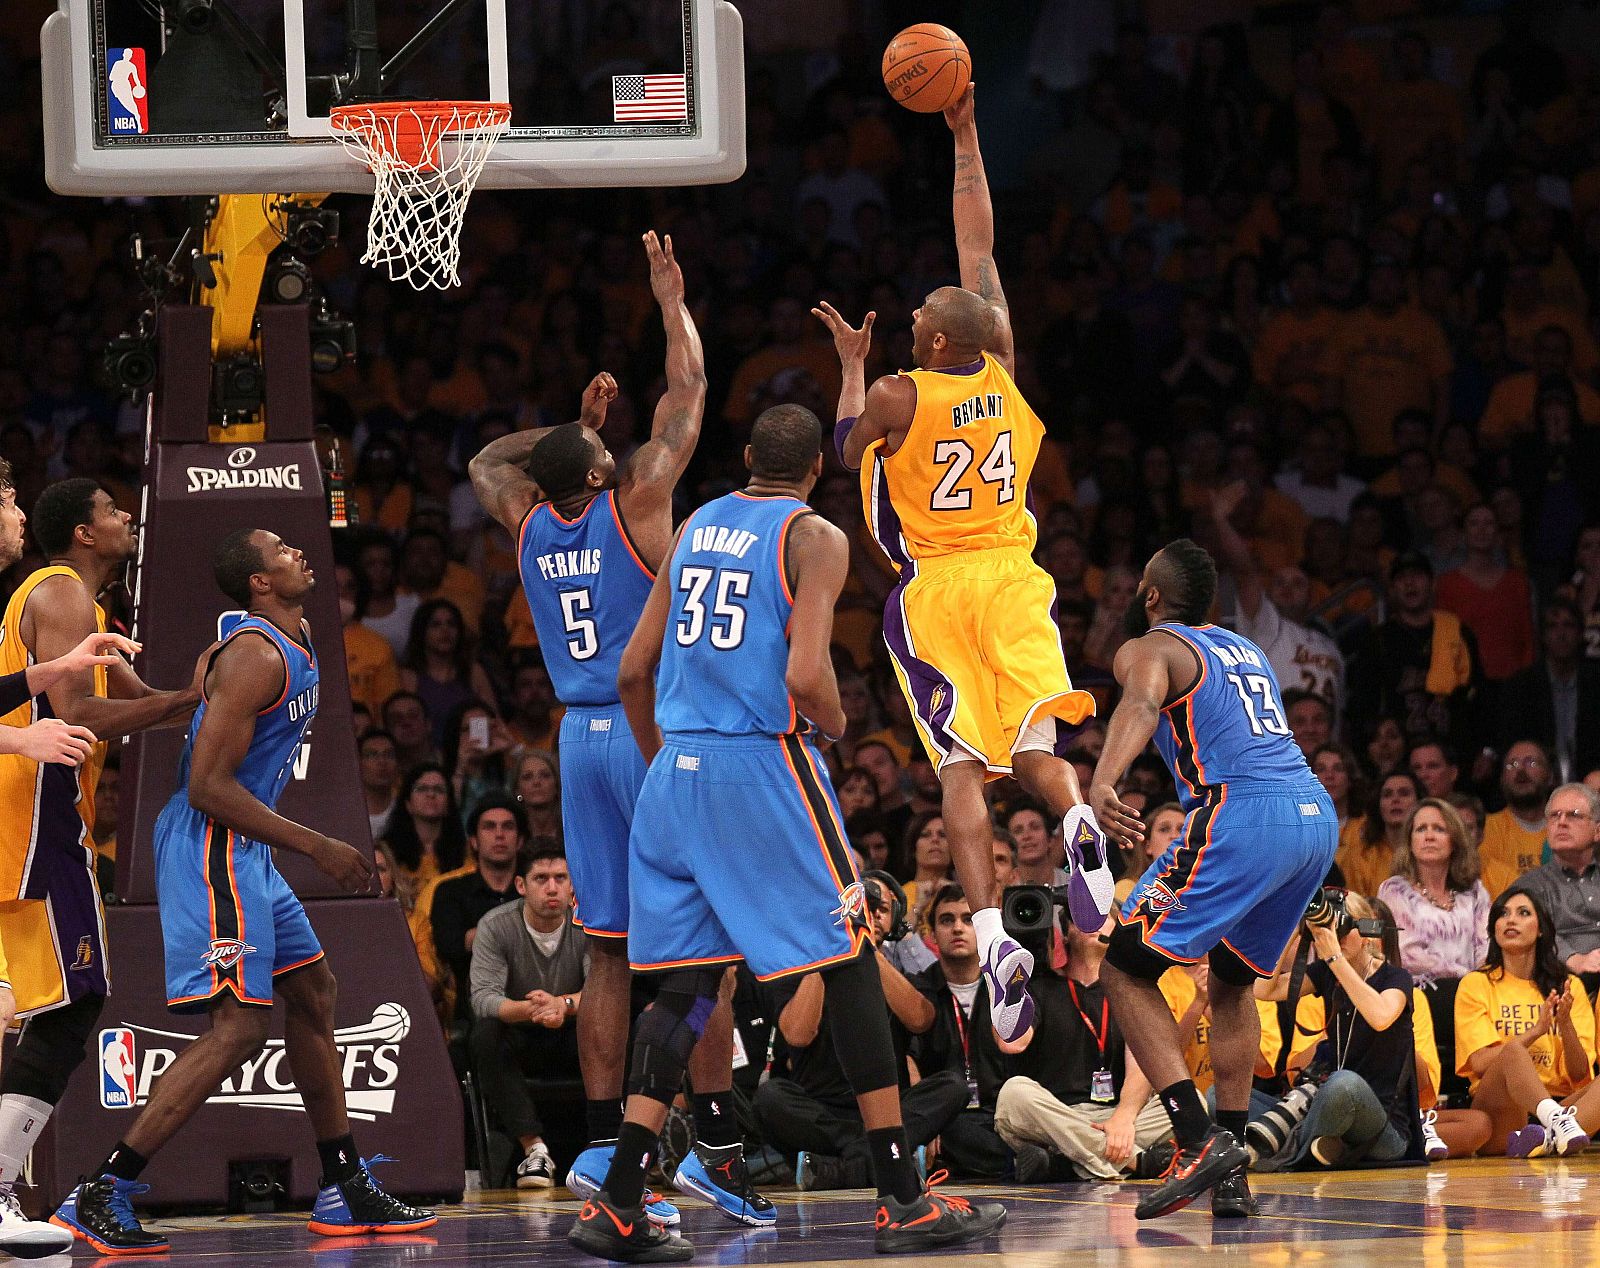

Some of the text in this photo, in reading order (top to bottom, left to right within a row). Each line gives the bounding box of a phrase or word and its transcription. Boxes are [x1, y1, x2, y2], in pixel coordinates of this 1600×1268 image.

[114, 117, 136, 130] NBA
[952, 393, 1003, 430] BRYANT
[186, 464, 302, 493] SPALDING
[930, 430, 1016, 511] 24
[691, 525, 759, 559] DURANT
[536, 548, 602, 581] PERKINS
[559, 586, 600, 662] 5
[675, 564, 753, 652] 35
[1225, 671, 1291, 738] 13
[208, 945, 238, 961] OKC
[1501, 1004, 1521, 1019] BE
[106, 1090, 126, 1104] NBA
